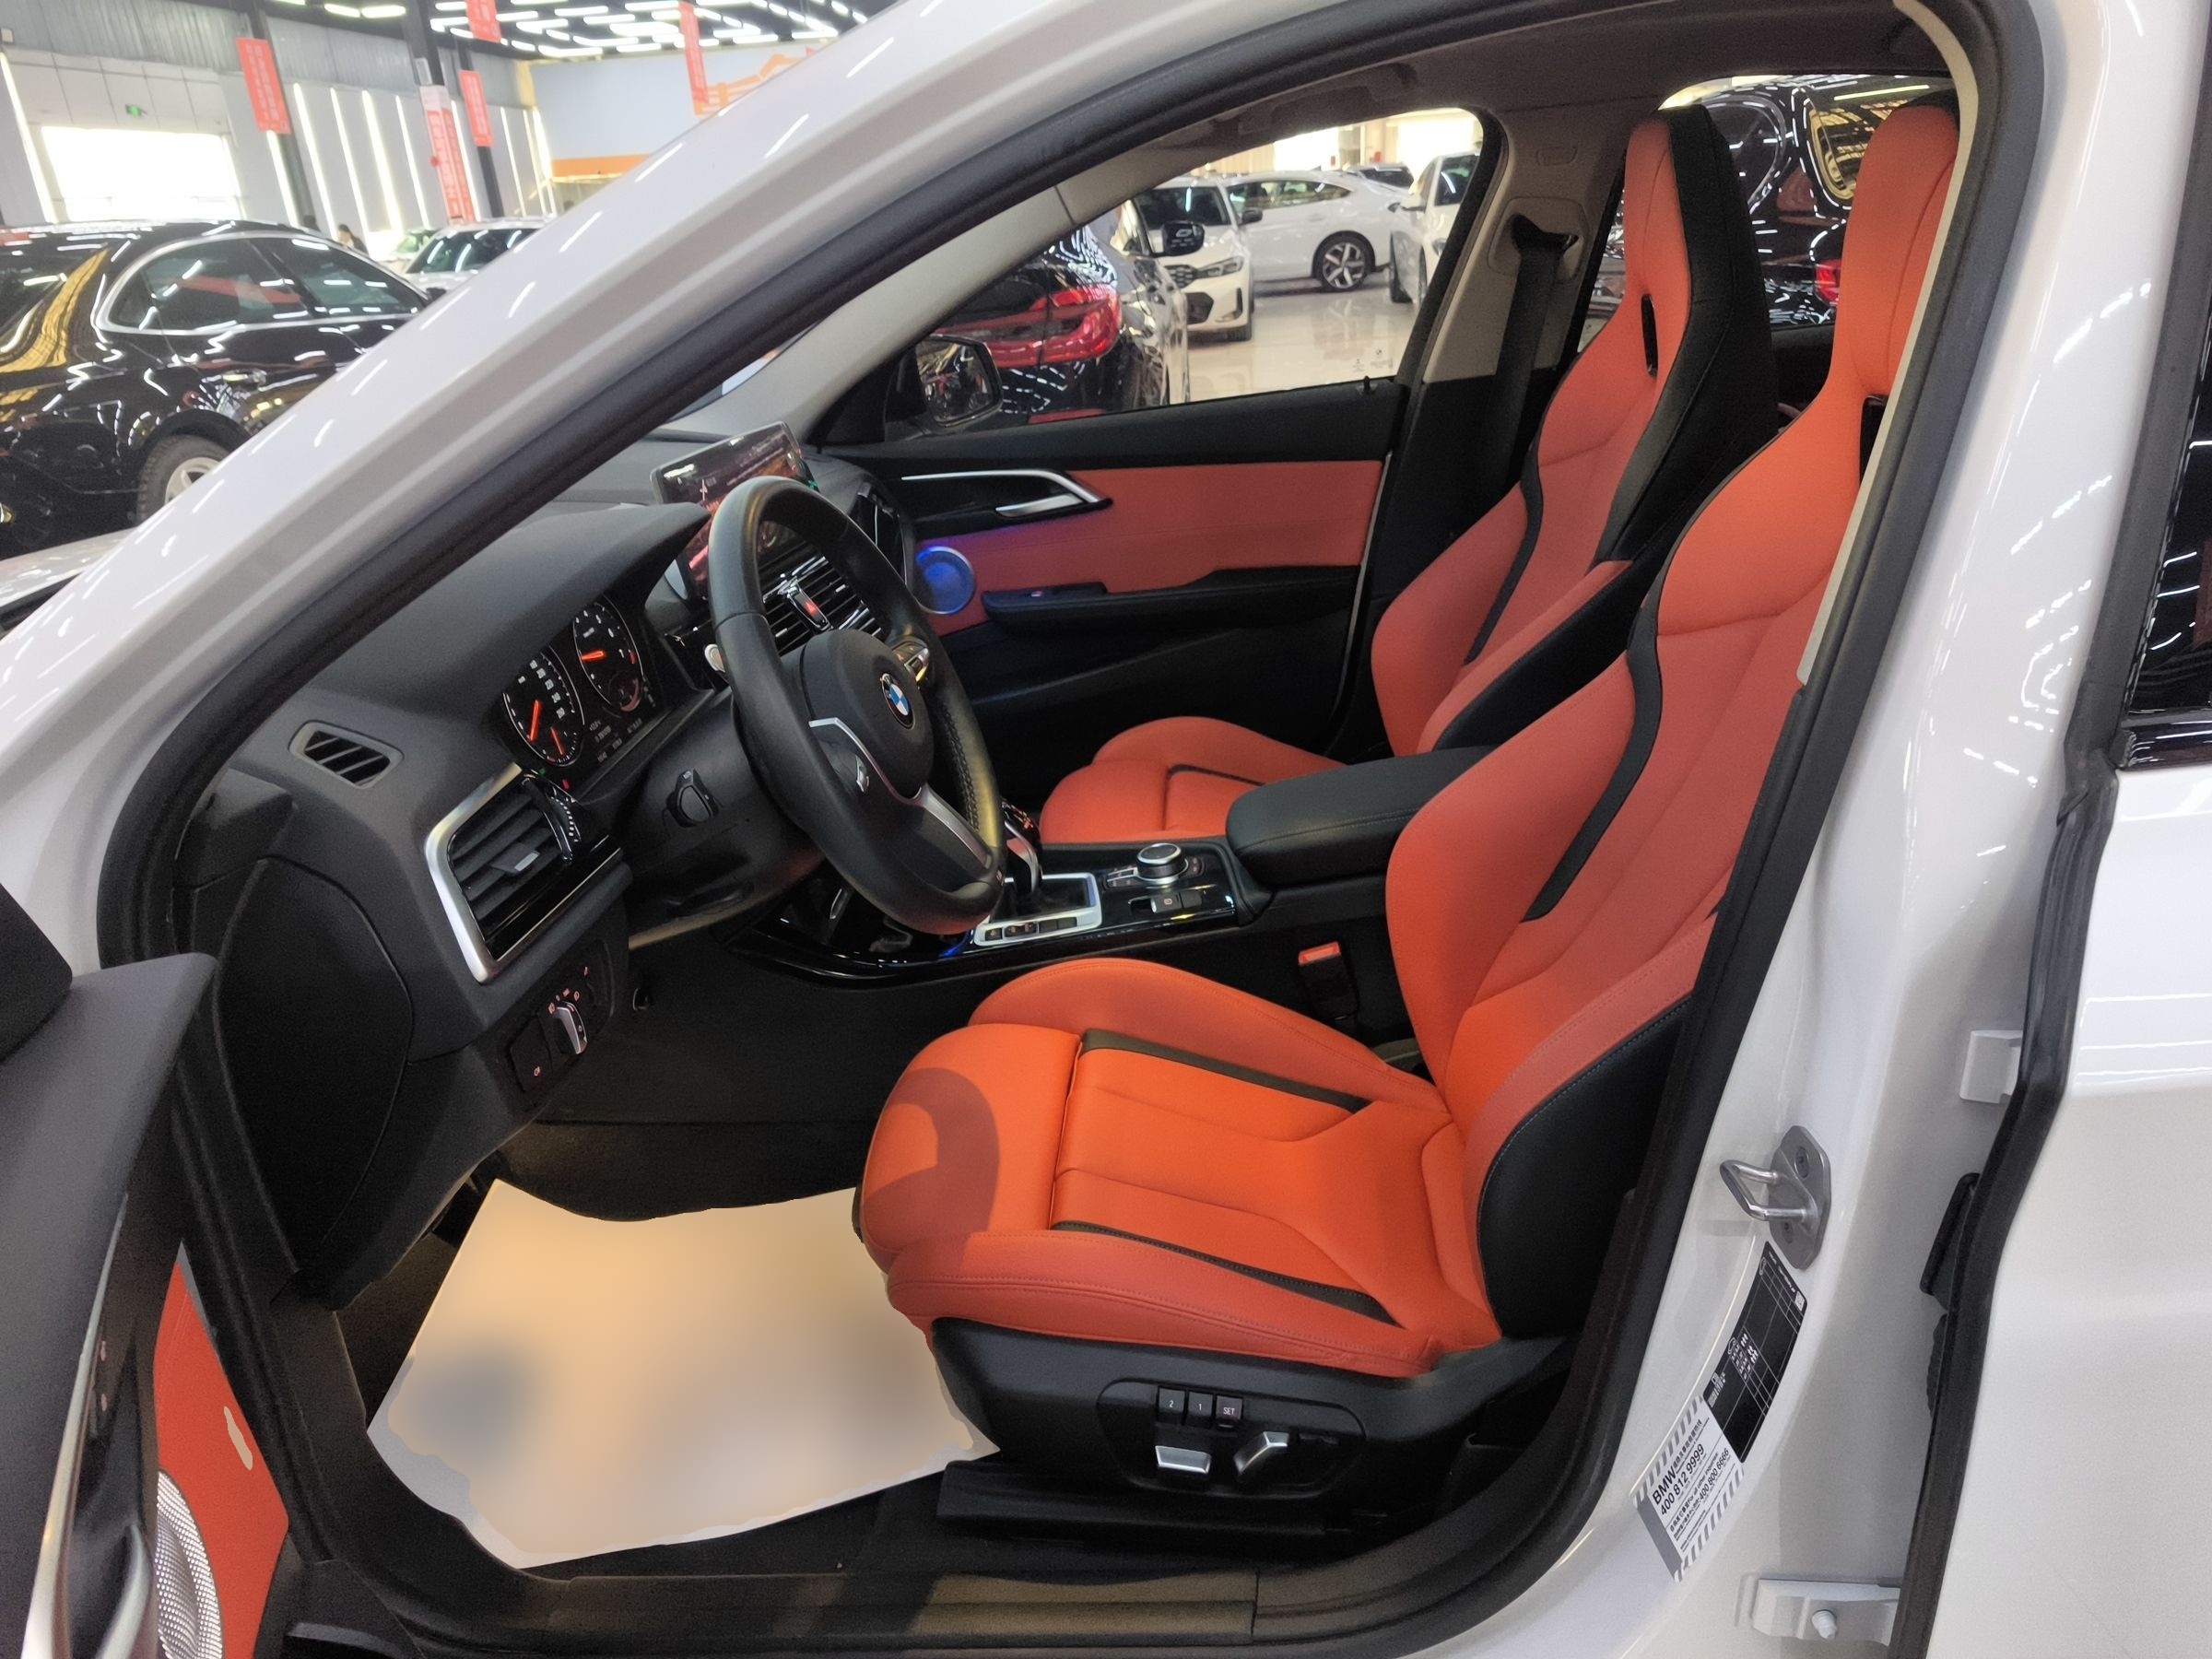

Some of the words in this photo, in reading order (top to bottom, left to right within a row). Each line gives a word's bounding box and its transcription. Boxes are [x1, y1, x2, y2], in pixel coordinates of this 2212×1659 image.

[1170, 1400, 1174, 1408] 2
[1223, 1406, 1235, 1415] SET
[1652, 1465, 1677, 1505] BMW
[1661, 1492, 1675, 1514] 400
[1673, 1471, 1688, 1495] 812
[1686, 1443, 1703, 1474] 9999
[1700, 1483, 1709, 1500] 400
[1707, 1467, 1717, 1485] 800
[1716, 1448, 1728, 1469] 6666
